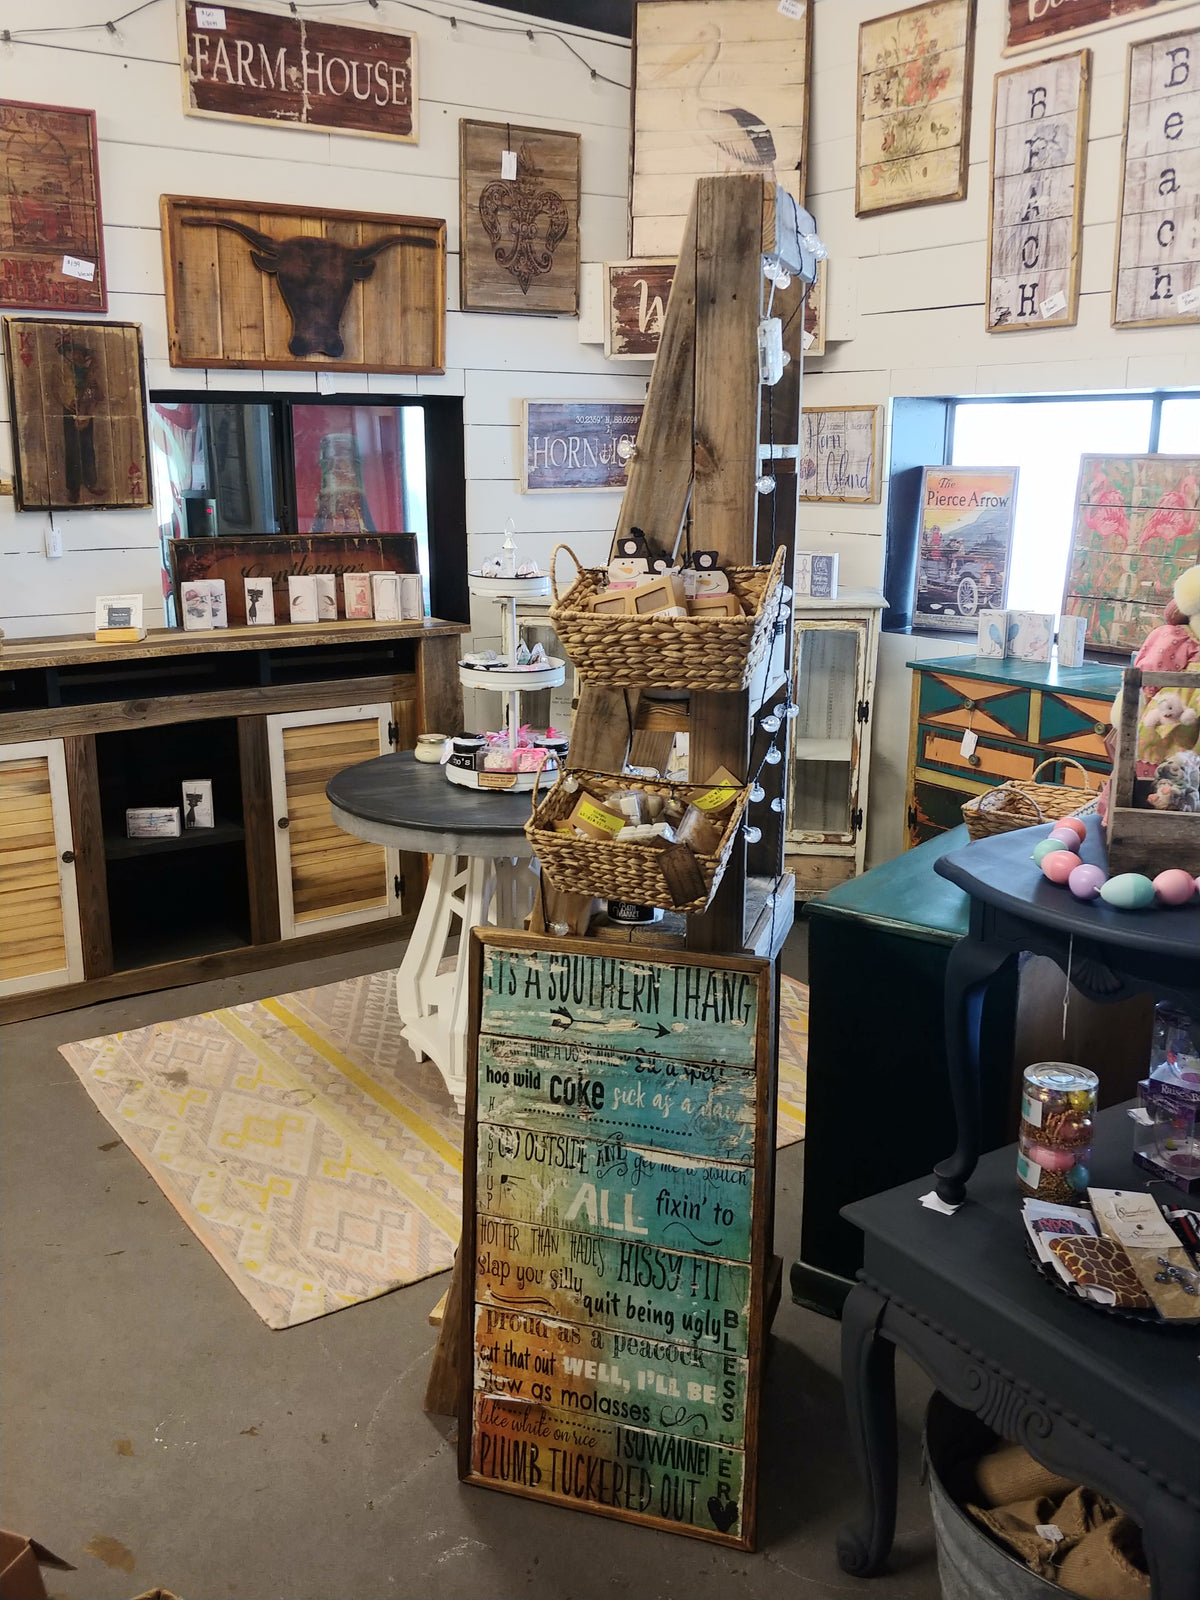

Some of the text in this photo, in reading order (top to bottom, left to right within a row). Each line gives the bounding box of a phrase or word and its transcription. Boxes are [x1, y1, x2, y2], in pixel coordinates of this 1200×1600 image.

[192, 33, 408, 106] FARM HOUSE
[1150, 47, 1190, 301] Beach
[17, 331, 34, 351] K
[532, 436, 600, 470] HORN
[926, 490, 1010, 508] Pierce Arrow
[938, 477, 956, 489] The
[524, 951, 542, 1000] A
[548, 953, 662, 1014] SOUTHERN
[669, 965, 752, 1027] THANG
[486, 1065, 541, 1090] hog wild
[612, 1080, 647, 1111] sick
[652, 1093, 675, 1118] as
[681, 1097, 695, 1114] a
[525, 1131, 589, 1174] OUTSIDE
[656, 1188, 734, 1226] fixin' to
[480, 1216, 605, 1278] HOTTER THAN HADES
[516, 1265, 544, 1290] you
[583, 1291, 721, 1344] quit being ugly
[503, 1339, 531, 1371] that
[534, 1352, 556, 1376] out
[557, 1325, 582, 1345] as
[590, 1330, 605, 1350] a
[612, 1334, 707, 1369] peacock
[563, 1356, 717, 1405] WELL, I'LL BE
[480, 1398, 599, 1448] like white on rice
[530, 1383, 552, 1402] as
[561, 1388, 651, 1424] molasses
[480, 1431, 702, 1524] PLUMB TUCKERED OUT
